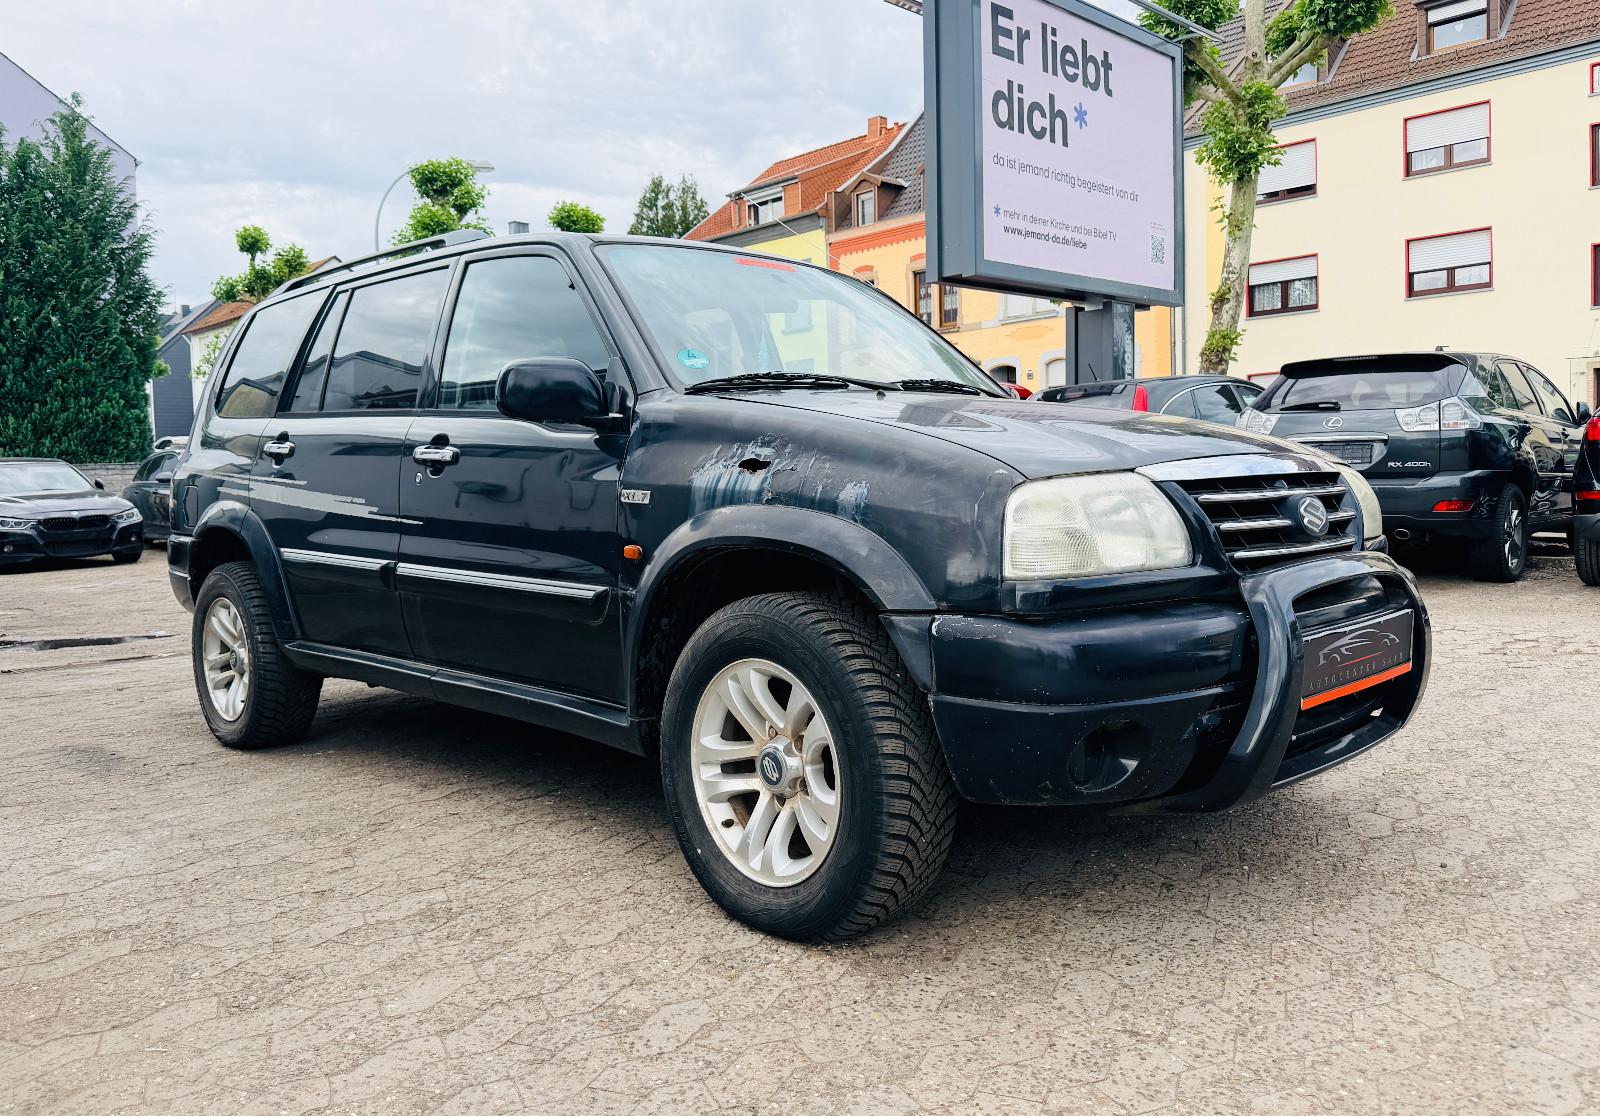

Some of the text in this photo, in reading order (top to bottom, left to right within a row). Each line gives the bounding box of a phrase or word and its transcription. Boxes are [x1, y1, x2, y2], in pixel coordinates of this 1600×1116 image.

[991, 1, 1113, 98] Er liebt
[992, 152, 1139, 203] da ist jemand richtig begeistert von dir
[1003, 209, 1117, 241] mehr in deiner Kirche und bei Bibel TV
[1003, 225, 1088, 250] www.jemand-da.de/liebe
